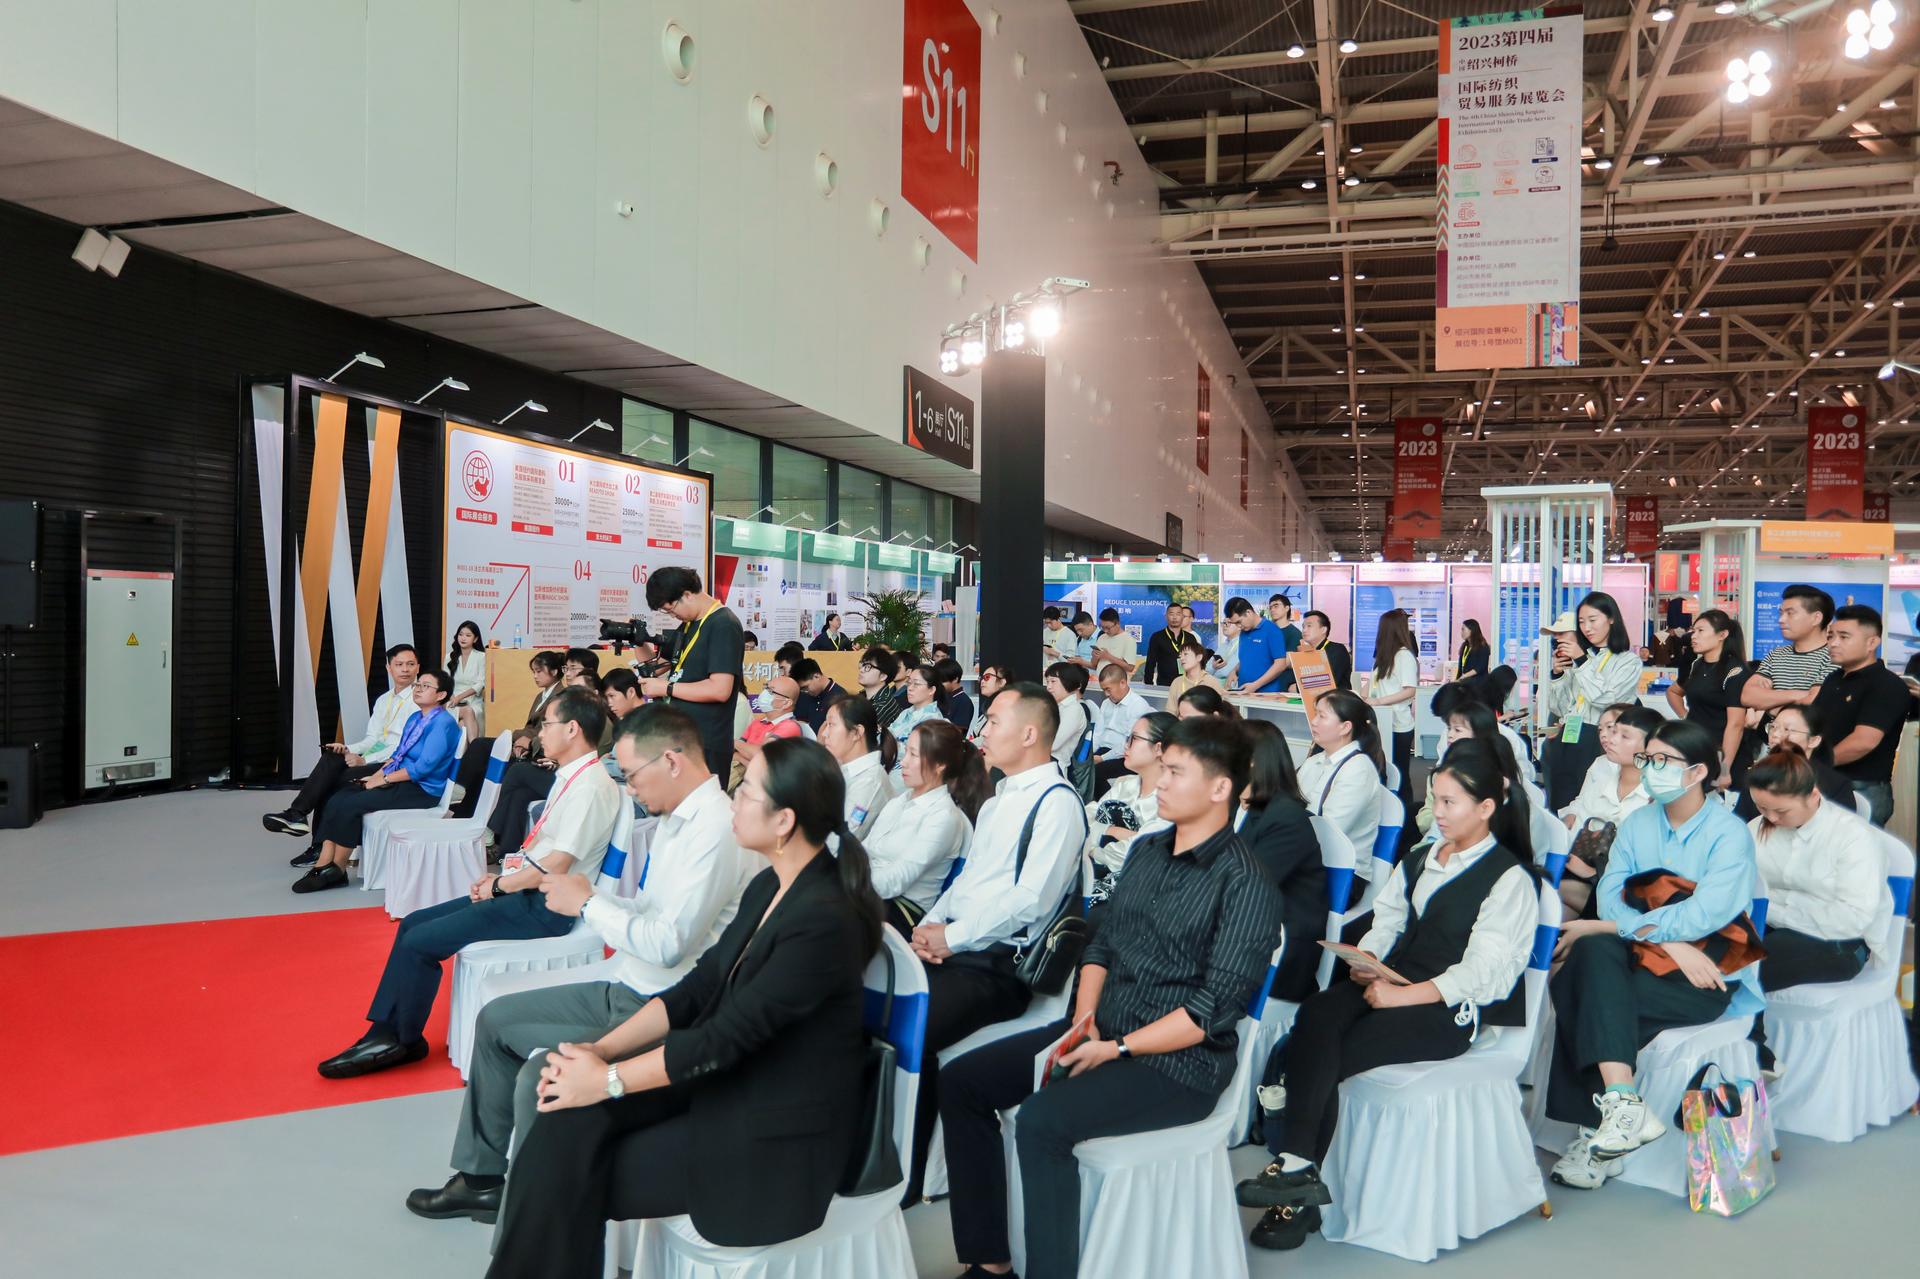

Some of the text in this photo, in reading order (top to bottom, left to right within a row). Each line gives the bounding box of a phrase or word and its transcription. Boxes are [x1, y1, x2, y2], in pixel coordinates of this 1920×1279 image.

[1459, 27, 1553, 51] 2023第四届
[1467, 54, 1519, 71] 绍兴柯桥
[1458, 77, 1519, 96] 国际纺织
[921, 37, 967, 169] S11
[1458, 88, 1566, 111] 贸易服务展览会
[947, 407, 964, 447] S11
[1398, 440, 1438, 456] 2023
[1813, 432, 1860, 450] 2023
[558, 459, 577, 484] 01
[625, 473, 641, 495] 02
[685, 485, 700, 505] 03
[1628, 511, 1656, 522] 2023
[1864, 508, 1887, 520] 023
[574, 559, 592, 581] 04
[632, 564, 648, 584] 05
[1104, 598, 1128, 606] REDUCE
[1128, 599, 1145, 607] YOUR
